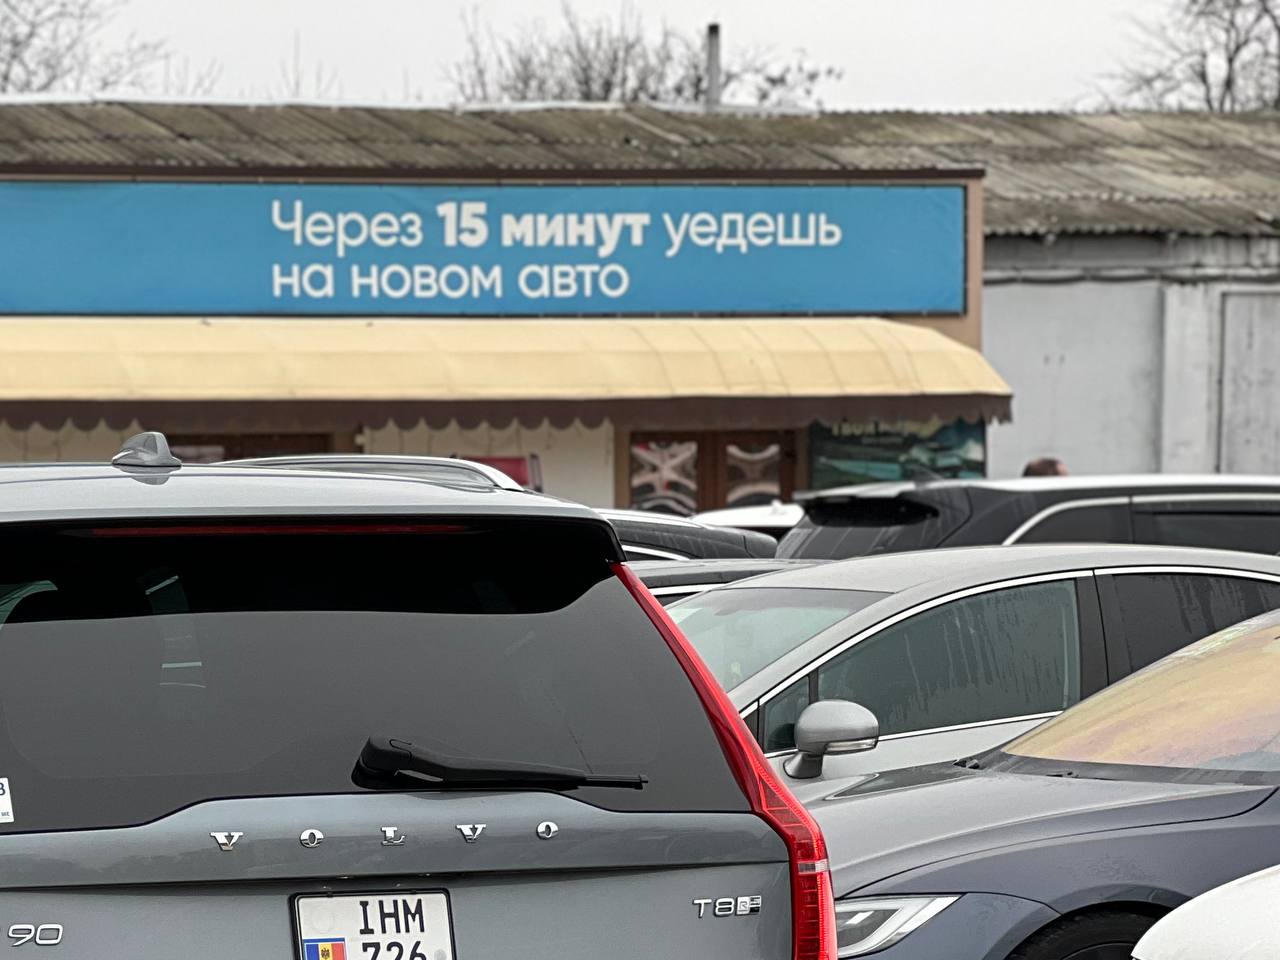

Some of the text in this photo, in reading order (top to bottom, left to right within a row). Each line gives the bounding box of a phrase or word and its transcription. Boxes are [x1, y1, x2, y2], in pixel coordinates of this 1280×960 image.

[271, 199, 843, 258] Через 15 минут уедешь
[271, 263, 630, 299] на новом авто
[210, 820, 560, 851] VOLVO
[359, 898, 426, 935] IHM
[693, 897, 735, 918] T8
